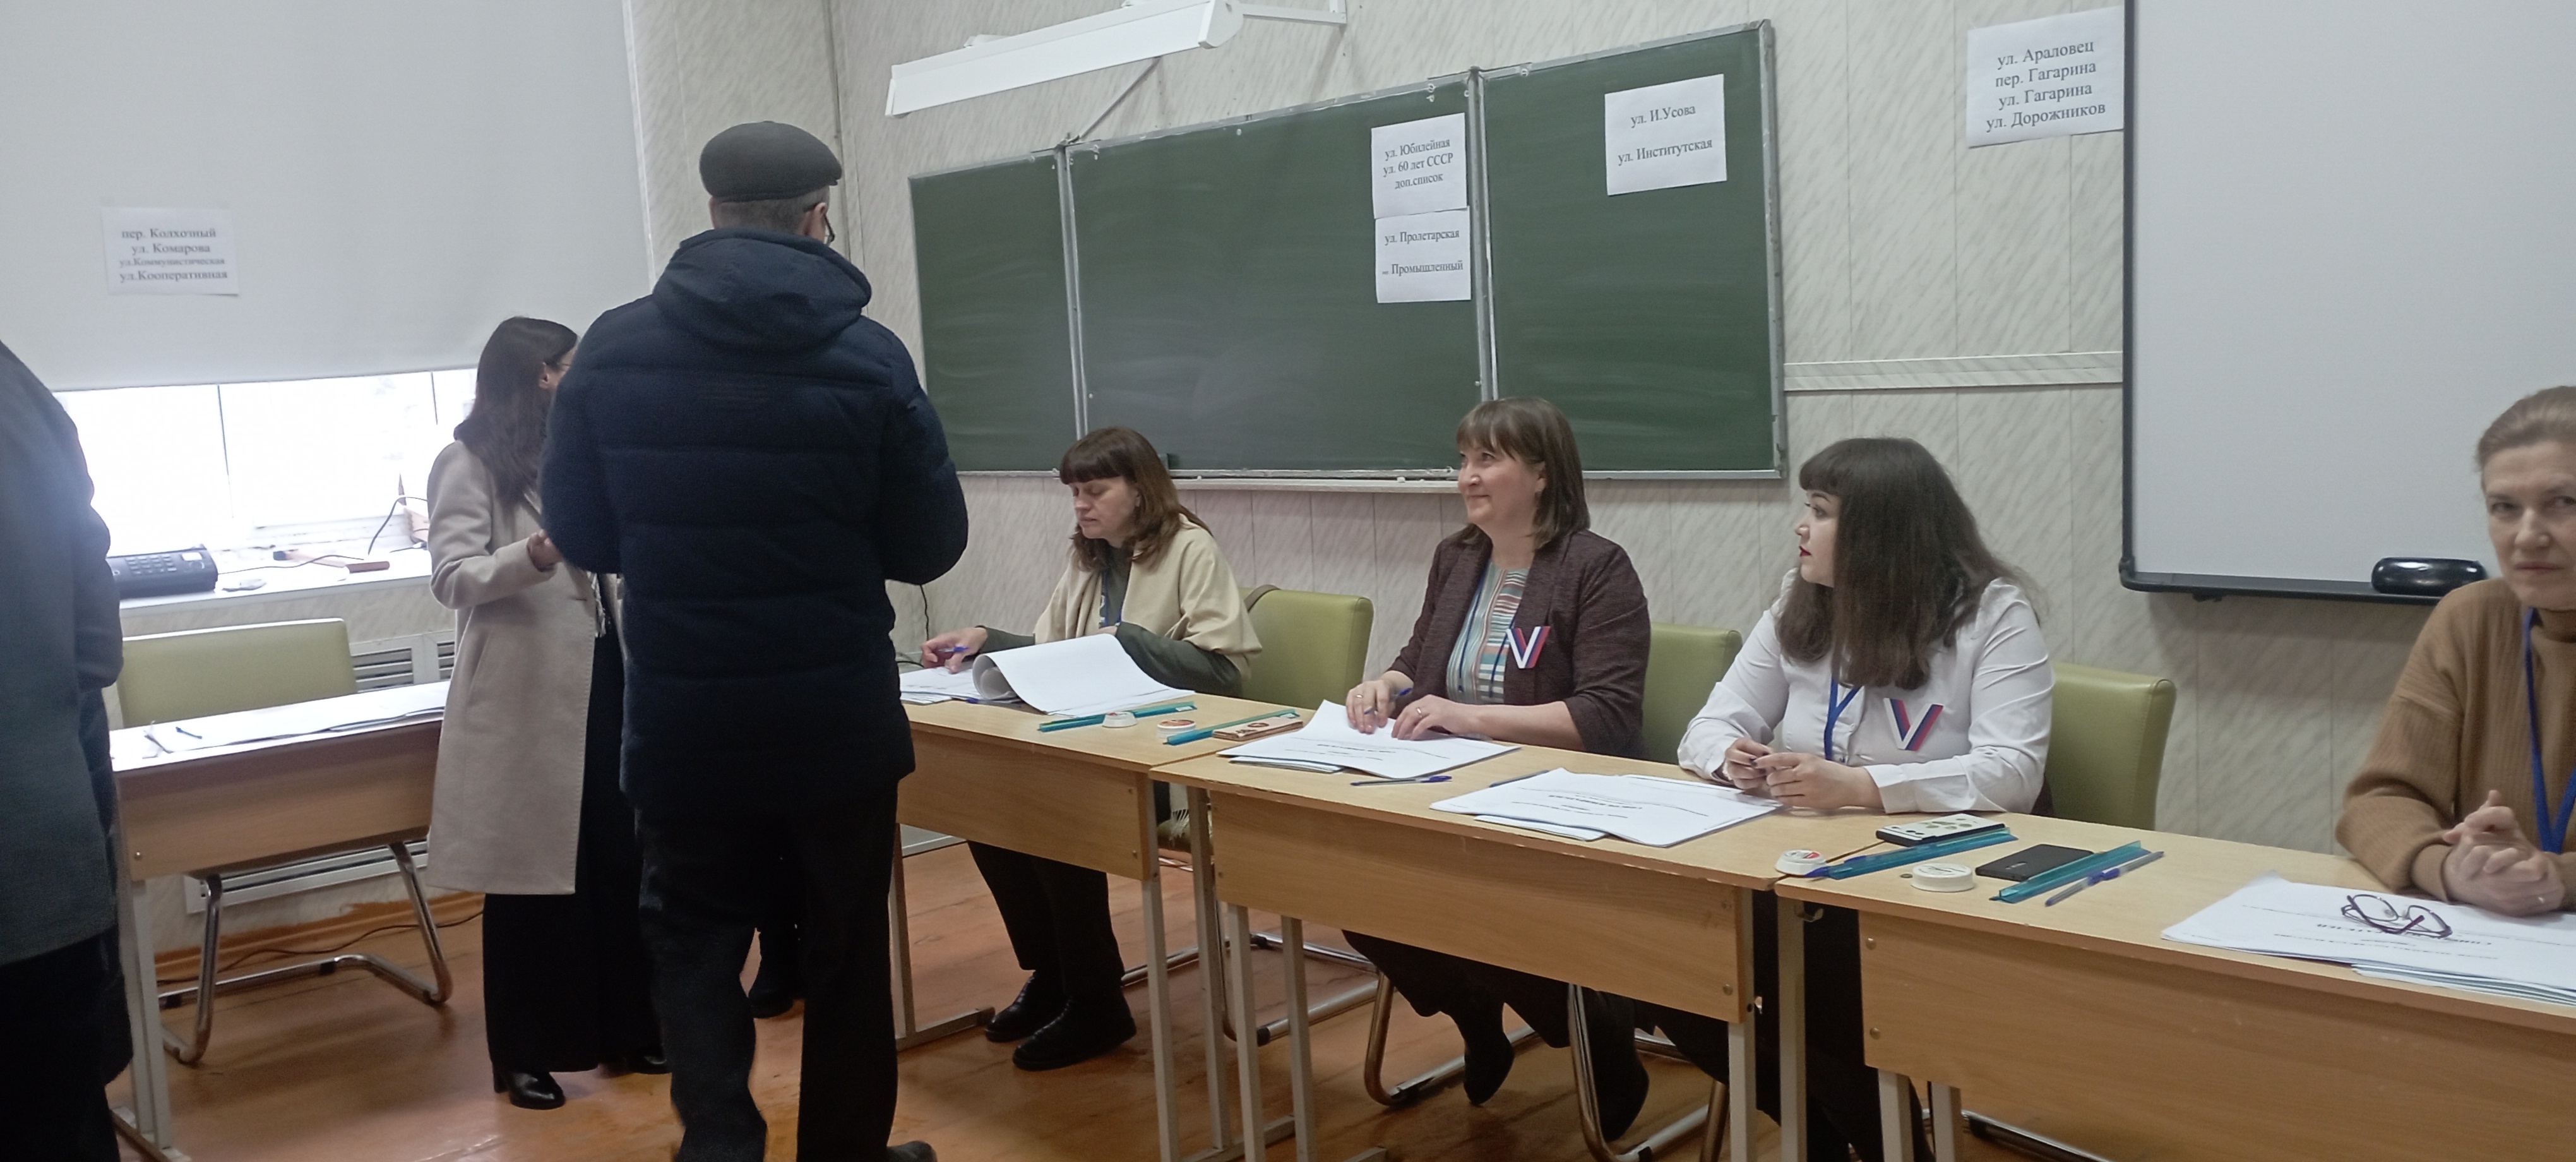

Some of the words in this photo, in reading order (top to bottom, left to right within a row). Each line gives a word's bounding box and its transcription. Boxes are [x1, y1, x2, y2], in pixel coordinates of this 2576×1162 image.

[1998, 55, 2018, 70] ул.
[2023, 42, 2094, 64] Араловец
[1995, 75, 2024, 88] пер.
[2029, 63, 2096, 82] Гагарина
[1998, 95, 2019, 111] ул.
[2024, 84, 2092, 104] Гагарина
[1631, 116, 1647, 128] ул.
[1650, 105, 1696, 121] И.Усова
[1986, 117, 2007, 133] ул.
[2011, 104, 2106, 128] Дорожников
[1385, 150, 1397, 161] ул.
[1400, 139, 1450, 156] Юбилейная
[1618, 153, 1633, 166] ул.
[1637, 139, 1712, 160] Институтская
[1383, 167, 1395, 177] ул.
[1398, 161, 1409, 172] 60
[1410, 160, 1425, 171] лет
[1426, 152, 1453, 167] СССР
[1395, 174, 1443, 189] доп.список
[122, 229, 145, 241] пер.
[150, 228, 216, 238] Колхозный
[1385, 235, 1397, 246] ул.
[1400, 230, 1460, 244] Пролетарская
[131, 245, 148, 255] ул.
[153, 243, 210, 255] Комарова
[119, 270, 227, 283] ул.Кооперативная
[1392, 260, 1464, 277] Промышленный
